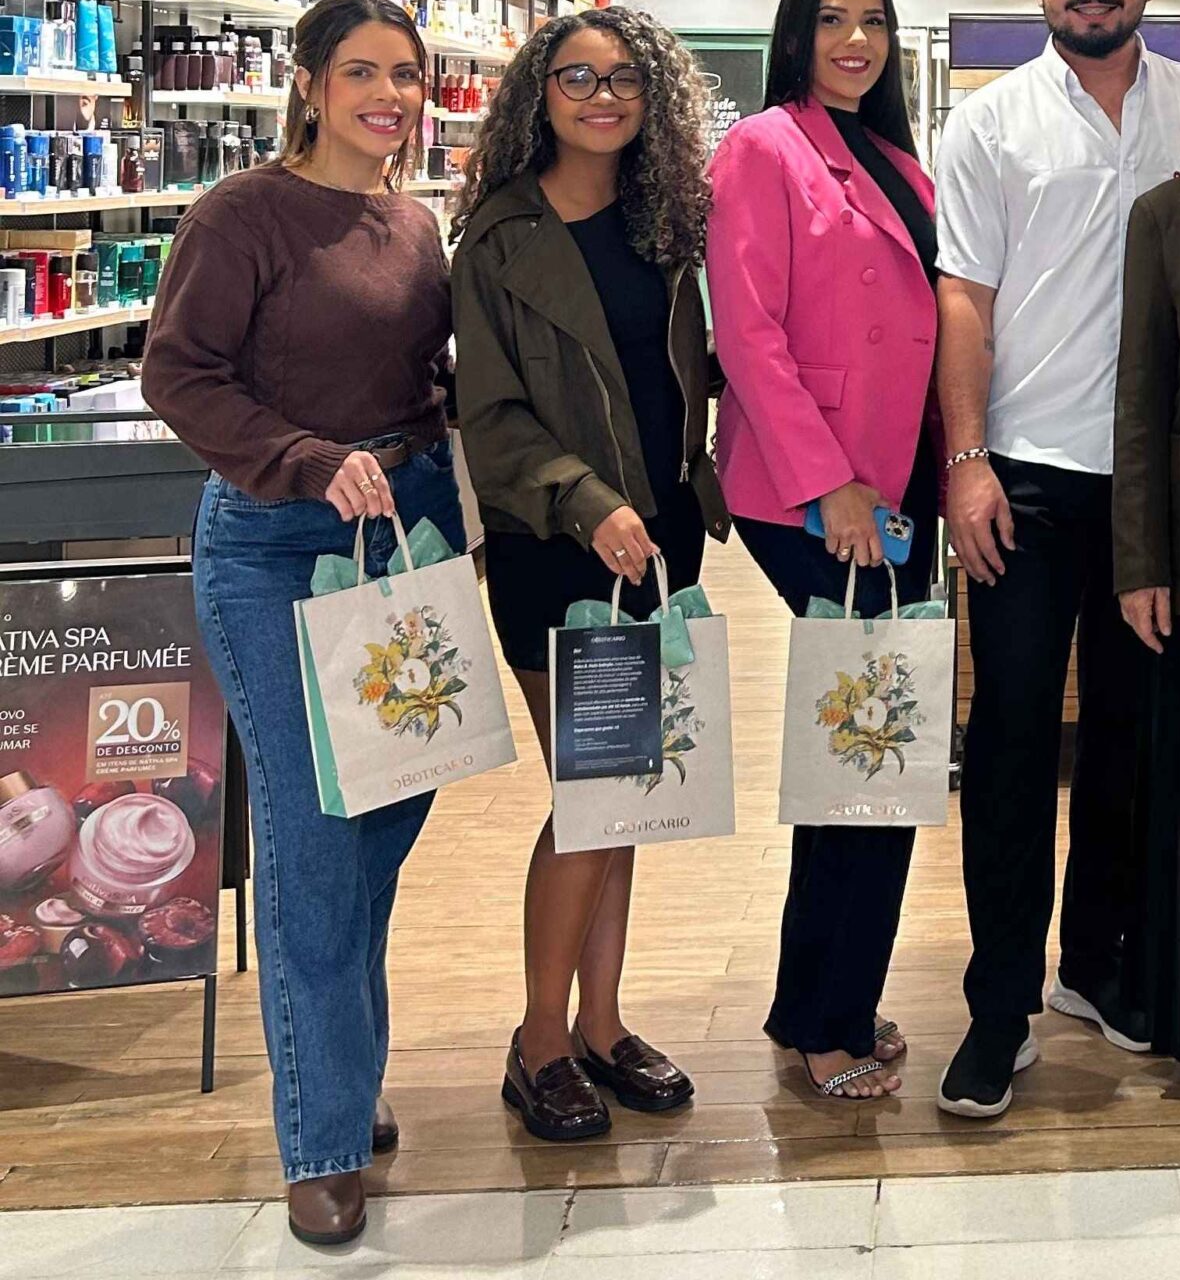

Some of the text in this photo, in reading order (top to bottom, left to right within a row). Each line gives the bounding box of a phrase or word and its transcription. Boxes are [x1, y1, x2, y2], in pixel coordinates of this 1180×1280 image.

[64, 627, 112, 648] SPA
[61, 643, 192, 673] PARFUMÉE
[4, 723, 39, 735] DE SE
[96, 697, 180, 745] 20%
[97, 742, 180, 757] DE DESCONTO
